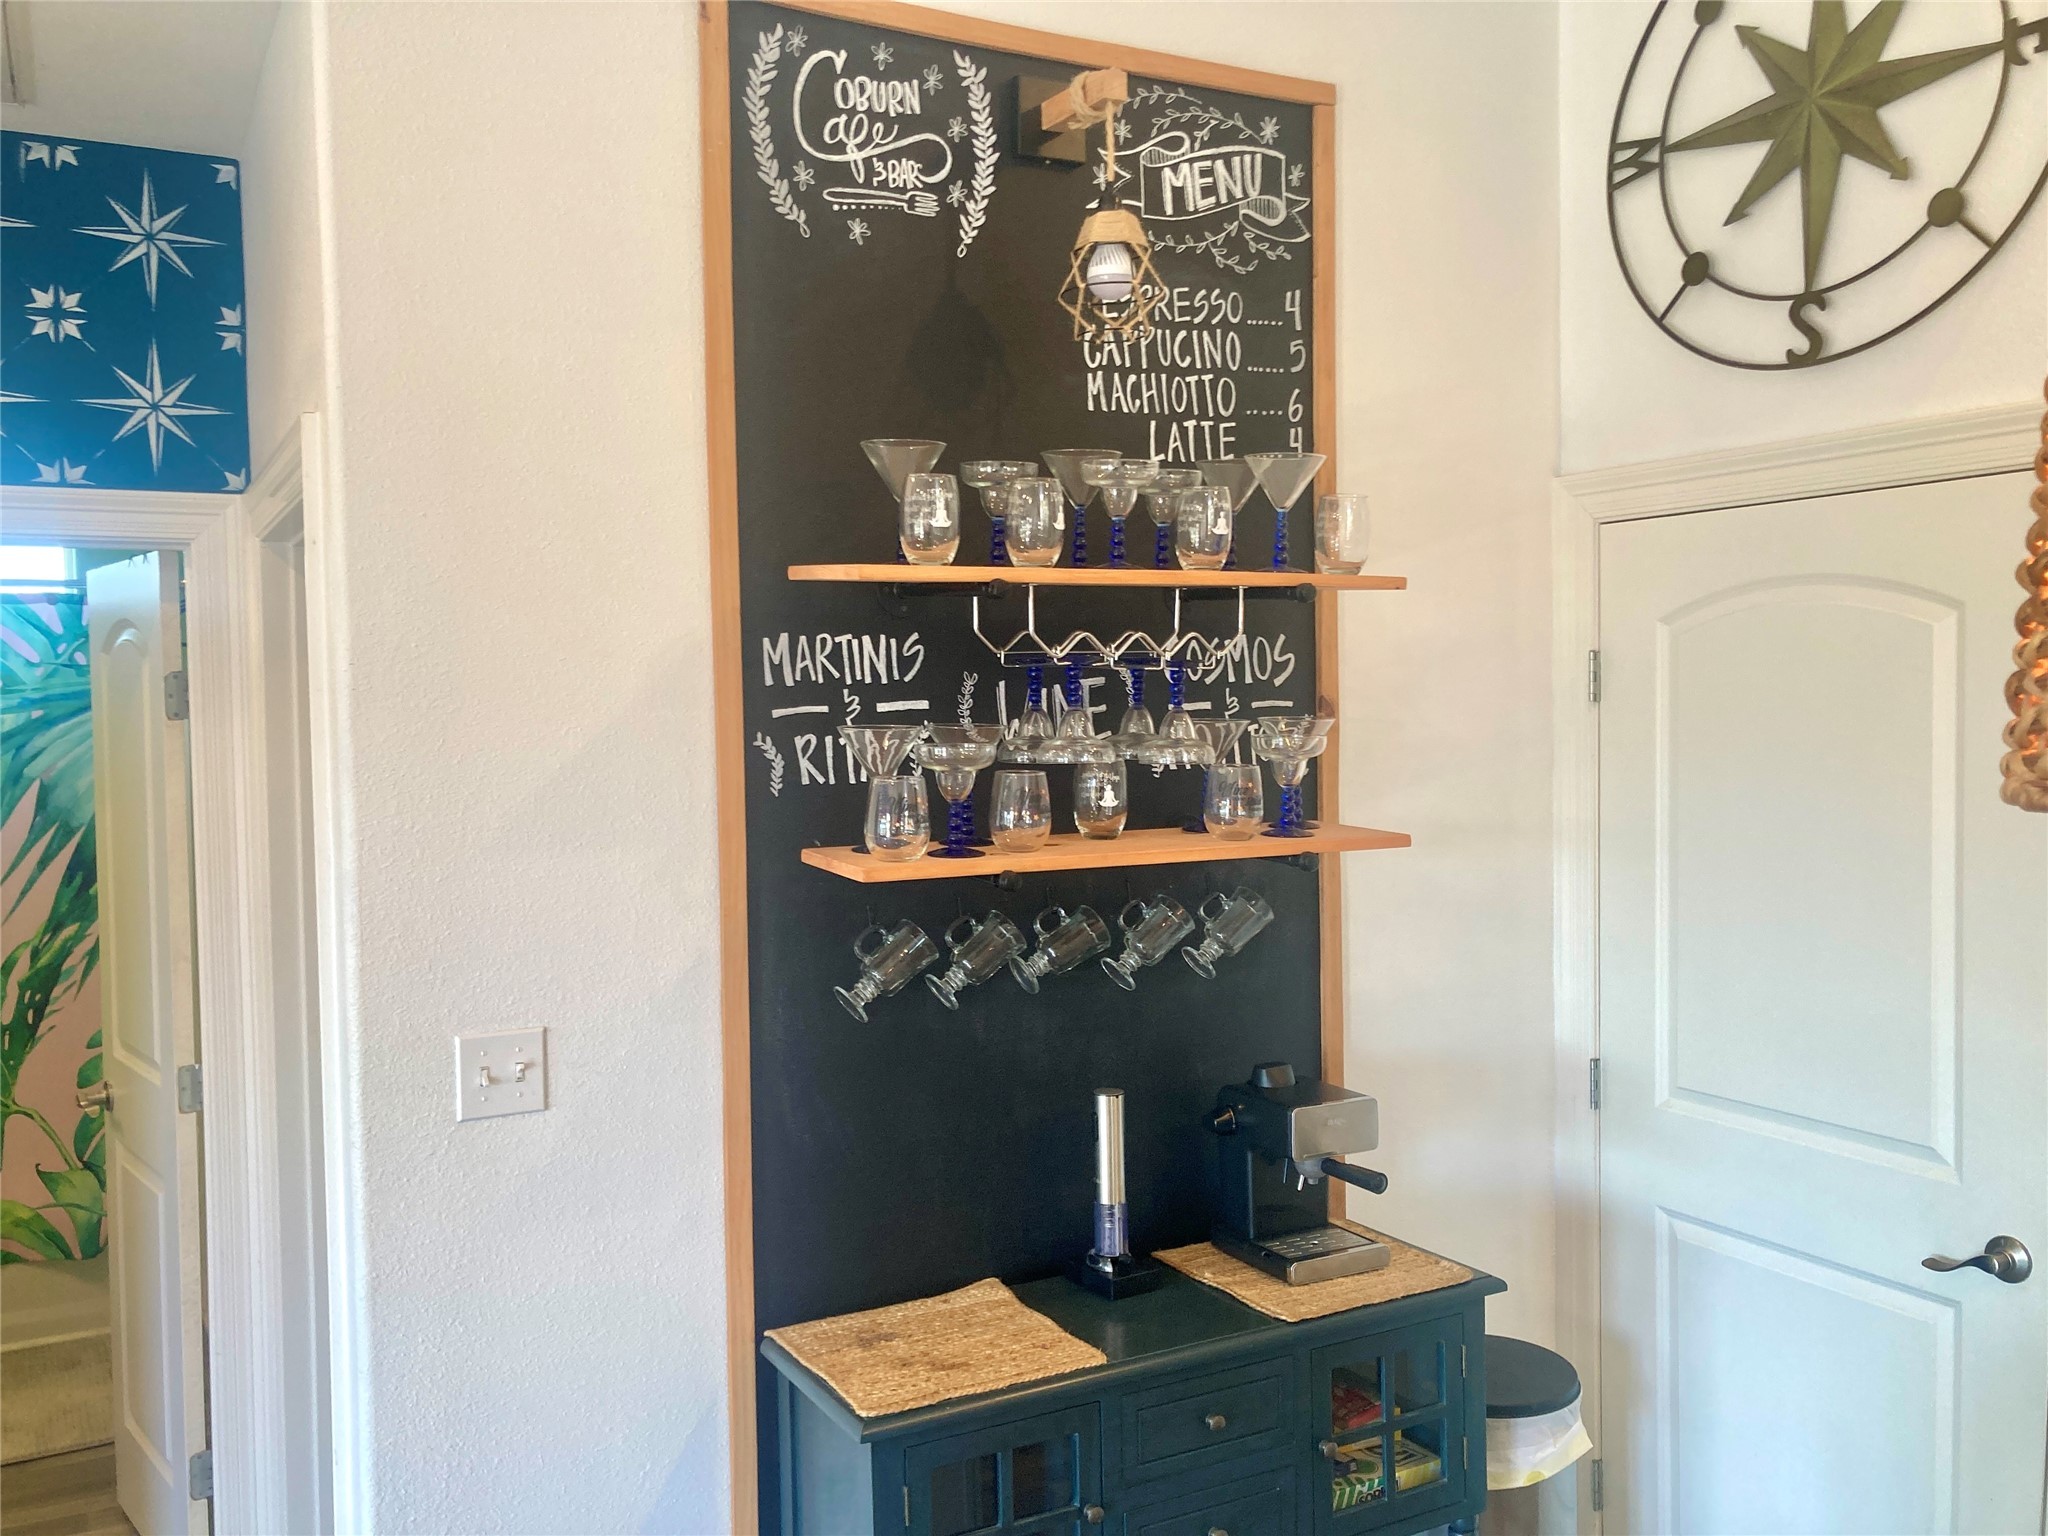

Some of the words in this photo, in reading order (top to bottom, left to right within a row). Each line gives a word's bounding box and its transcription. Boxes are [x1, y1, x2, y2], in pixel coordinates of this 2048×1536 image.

[888, 158, 923, 189] BAR
[1161, 153, 1263, 216] MENU
[1285, 289, 1302, 331] 4
[1083, 325, 1242, 372] CAPPUCINO
[1290, 340, 1306, 373] 5
[1087, 371, 1236, 417] MACHIOTTO
[1288, 389, 1304, 422] 6
[1150, 420, 1237, 463] LATTE
[1289, 427, 1303, 459] 4
[762, 632, 925, 687] MARTINIS
